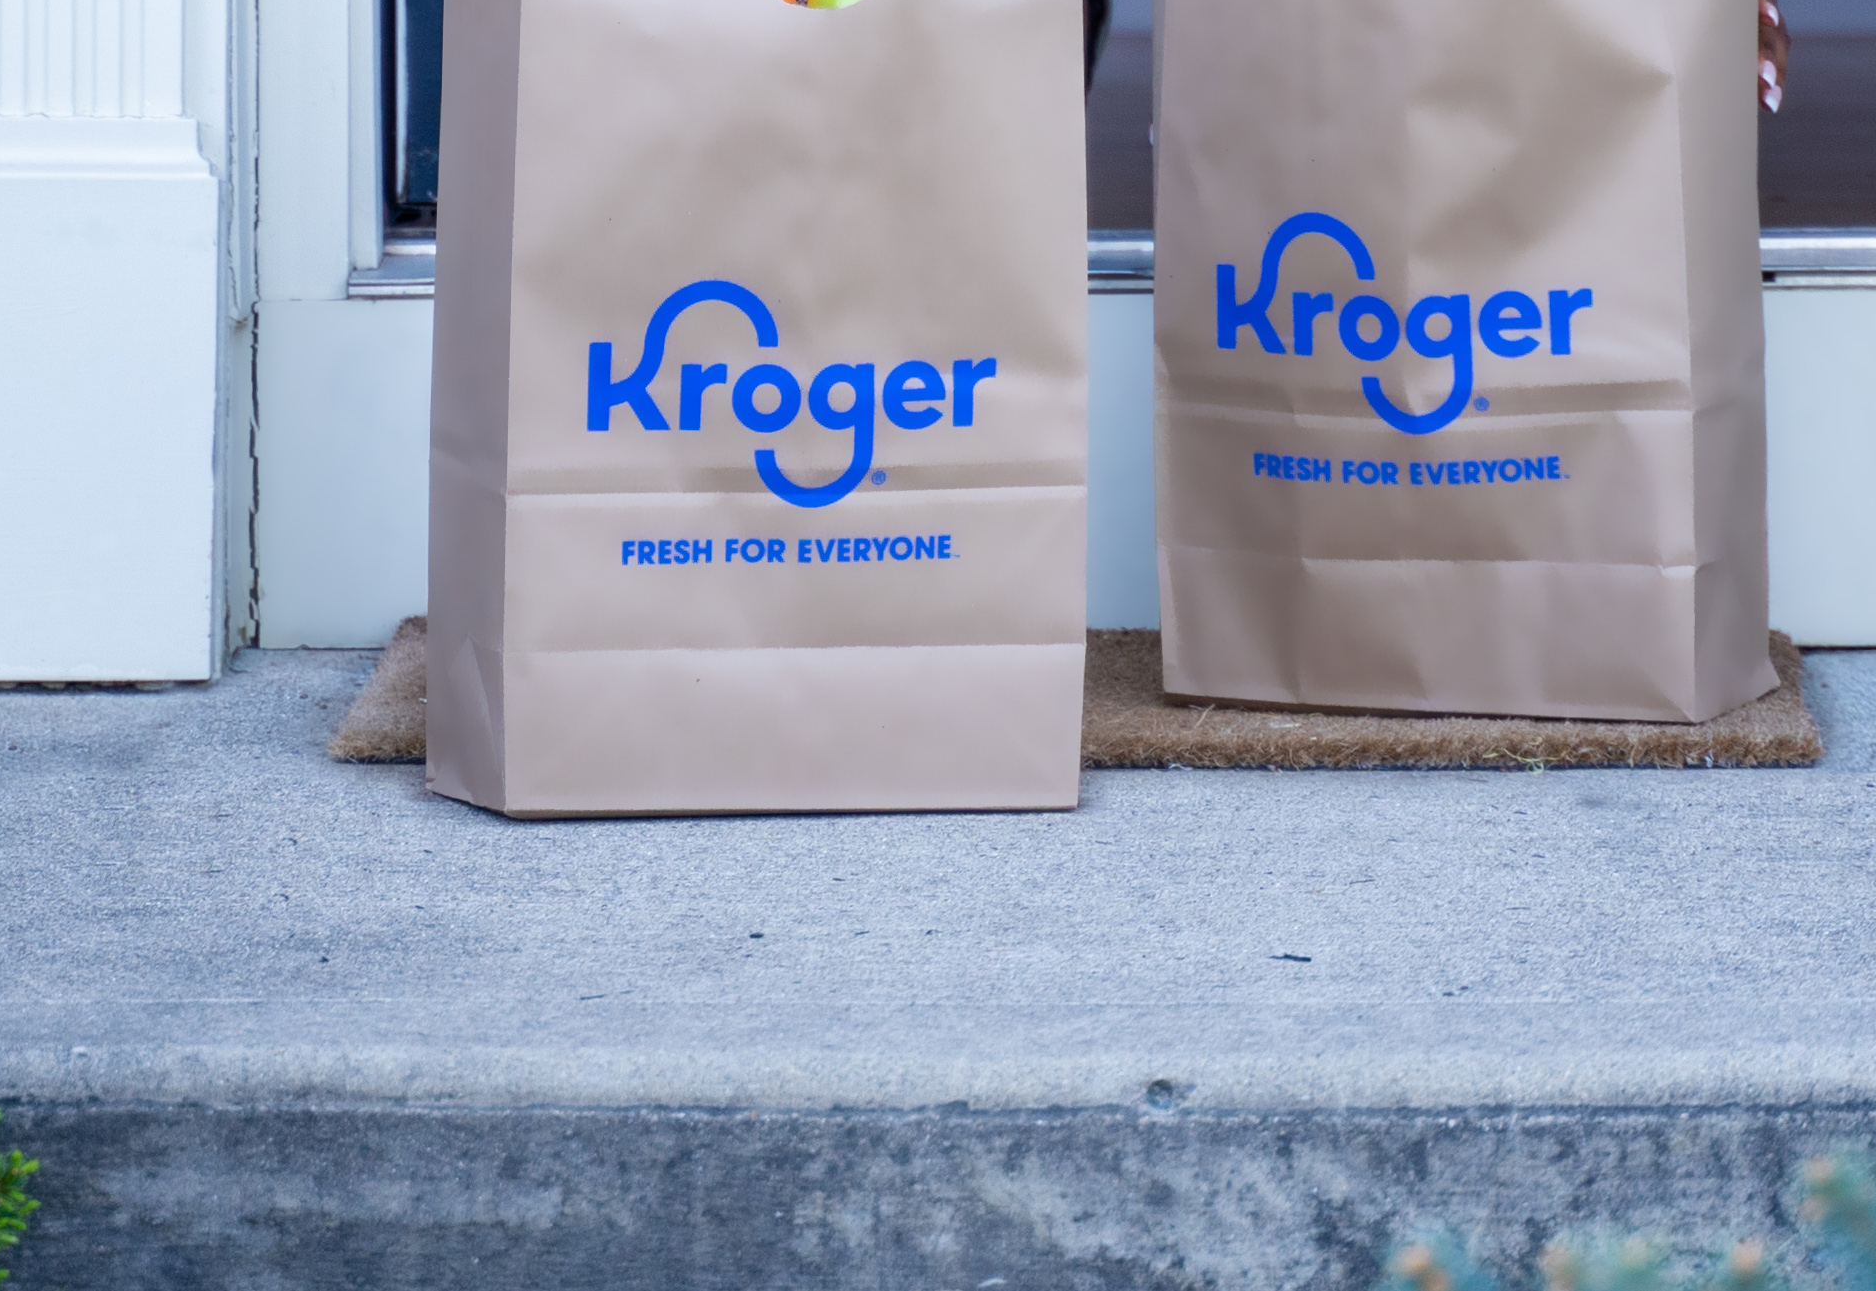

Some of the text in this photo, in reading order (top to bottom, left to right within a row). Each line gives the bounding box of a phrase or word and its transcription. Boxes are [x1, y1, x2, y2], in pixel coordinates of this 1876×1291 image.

[1215, 211, 1594, 436] Kroger
[586, 278, 998, 509] Kroger
[1252, 451, 1562, 486] FRESH FOR EVERYONE
[621, 533, 960, 566] FRESH FOR EVERYONE
